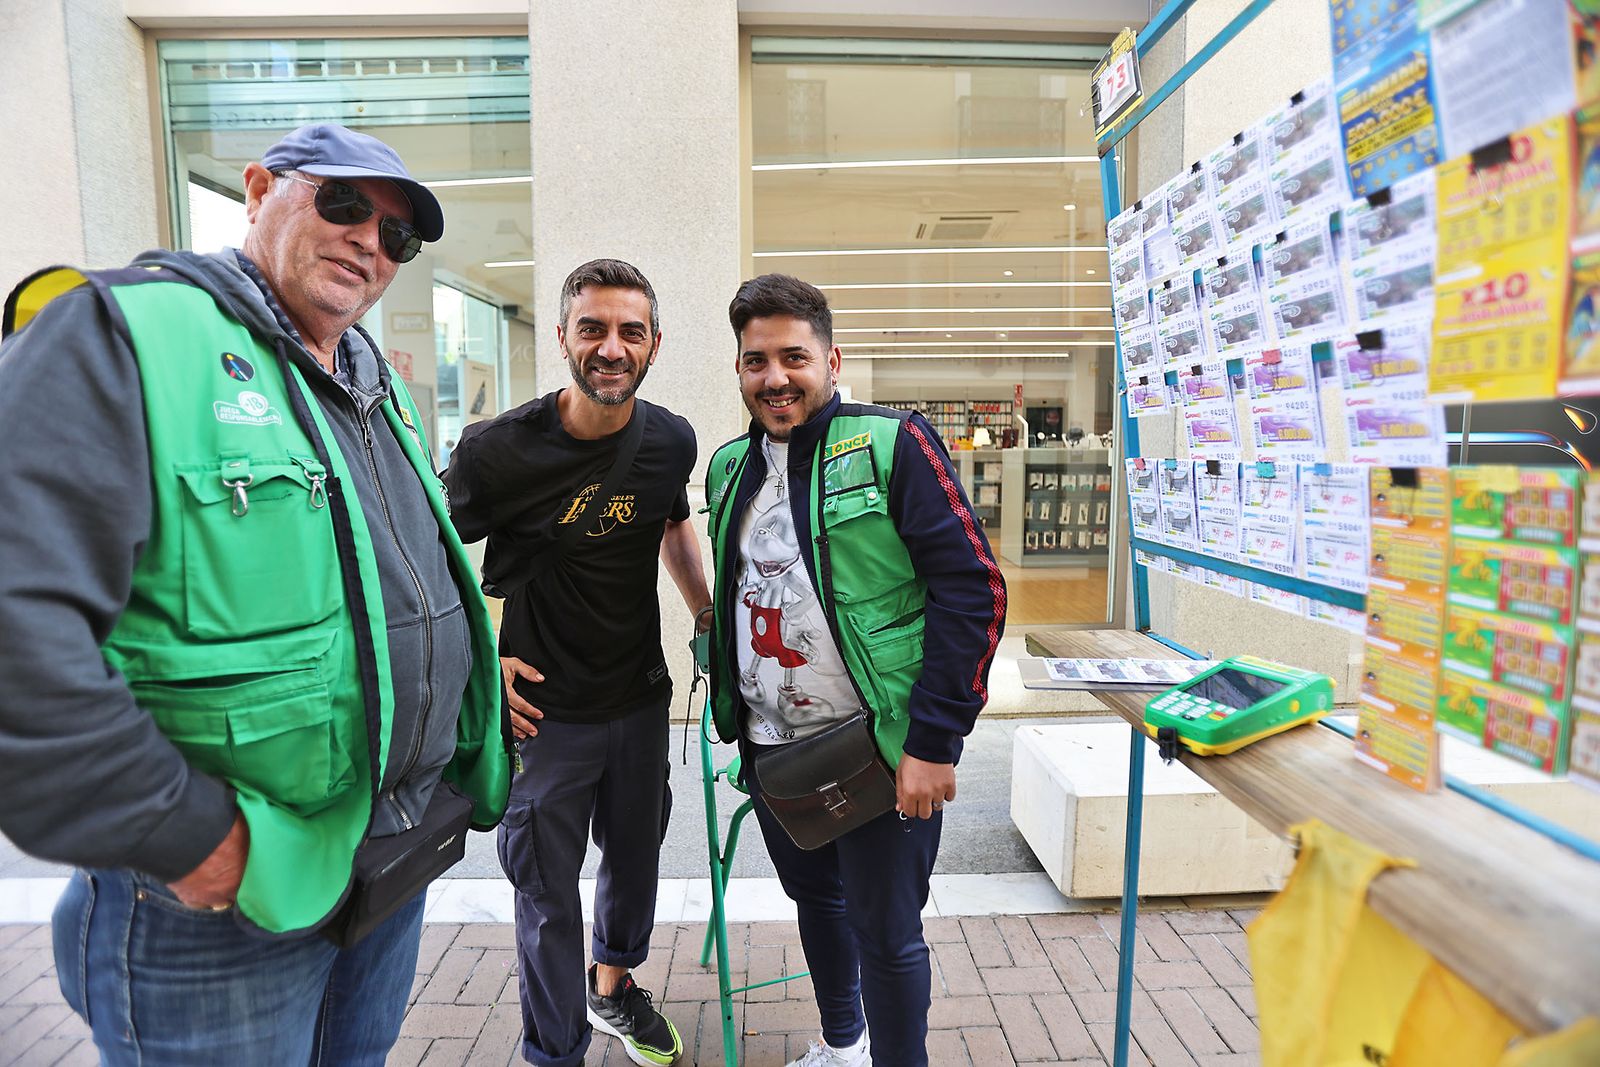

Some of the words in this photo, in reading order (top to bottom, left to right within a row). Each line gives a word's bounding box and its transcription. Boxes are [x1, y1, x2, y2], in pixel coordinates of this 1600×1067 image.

[1106, 62, 1125, 101] 73
[835, 434, 869, 453] ONCE
[755, 713, 765, 724] 100
